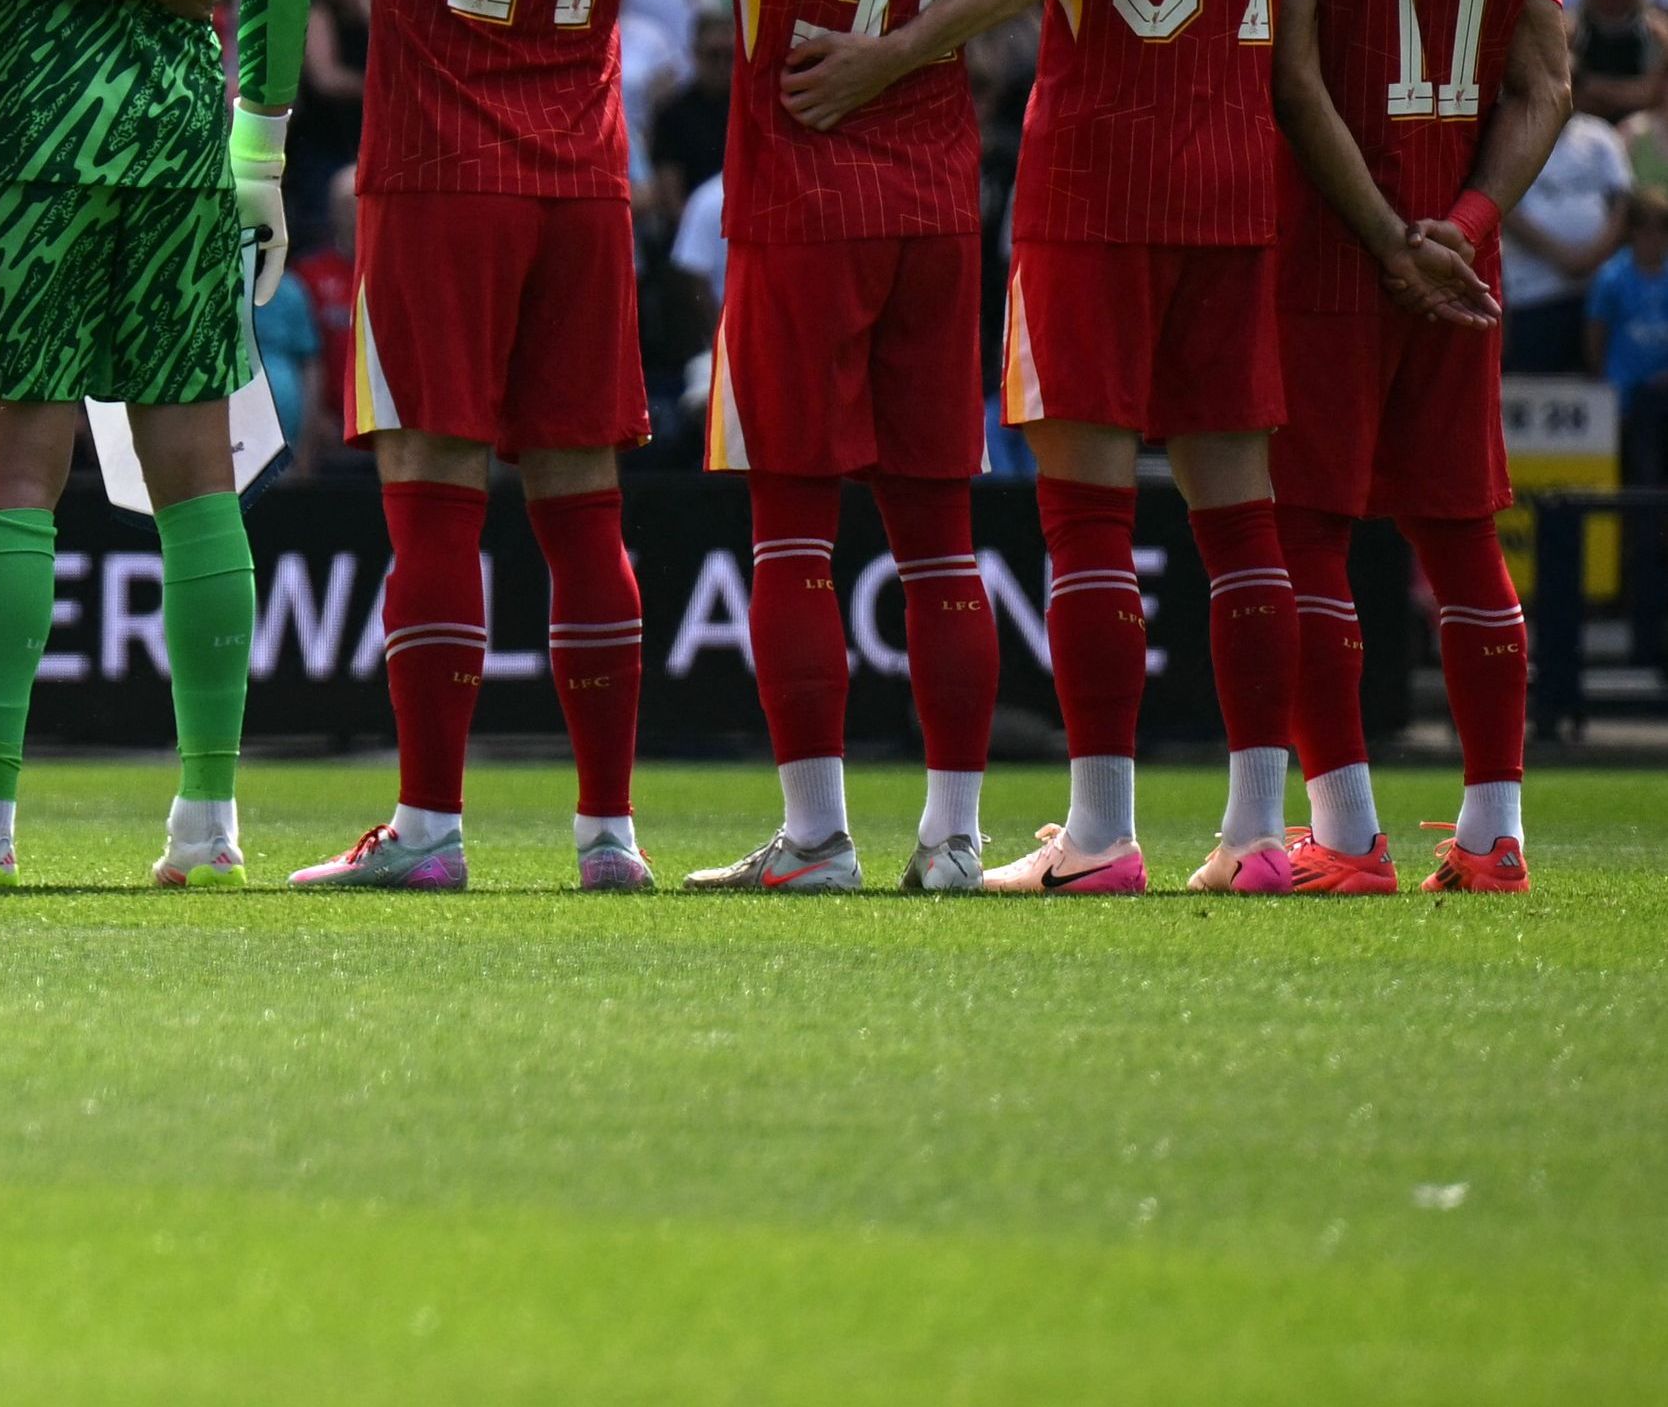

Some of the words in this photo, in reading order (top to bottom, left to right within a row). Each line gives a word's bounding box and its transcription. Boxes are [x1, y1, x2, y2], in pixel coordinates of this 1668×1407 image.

[805, 578, 835, 590] LFC
[942, 600, 982, 611] LFC
[1483, 642, 1519, 657] LFC
[453, 671, 480, 686] LFC
[569, 676, 610, 690] LFC
